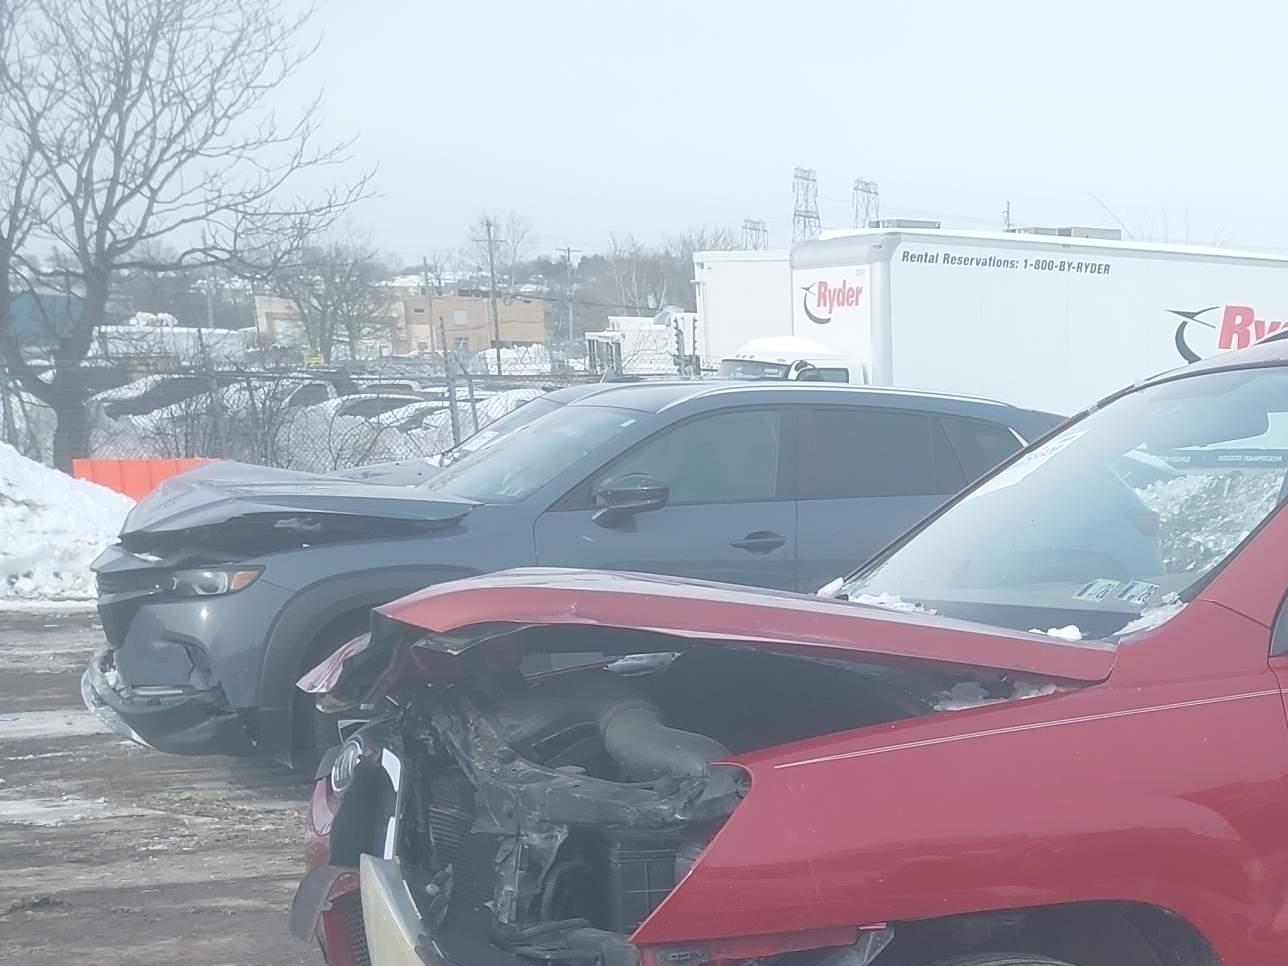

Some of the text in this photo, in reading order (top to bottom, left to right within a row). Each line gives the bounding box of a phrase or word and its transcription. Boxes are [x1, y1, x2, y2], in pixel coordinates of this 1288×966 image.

[901, 250, 1111, 275] Rental Reservations: 1-800-BY-RYDER
[816, 279, 864, 315] Ryder
